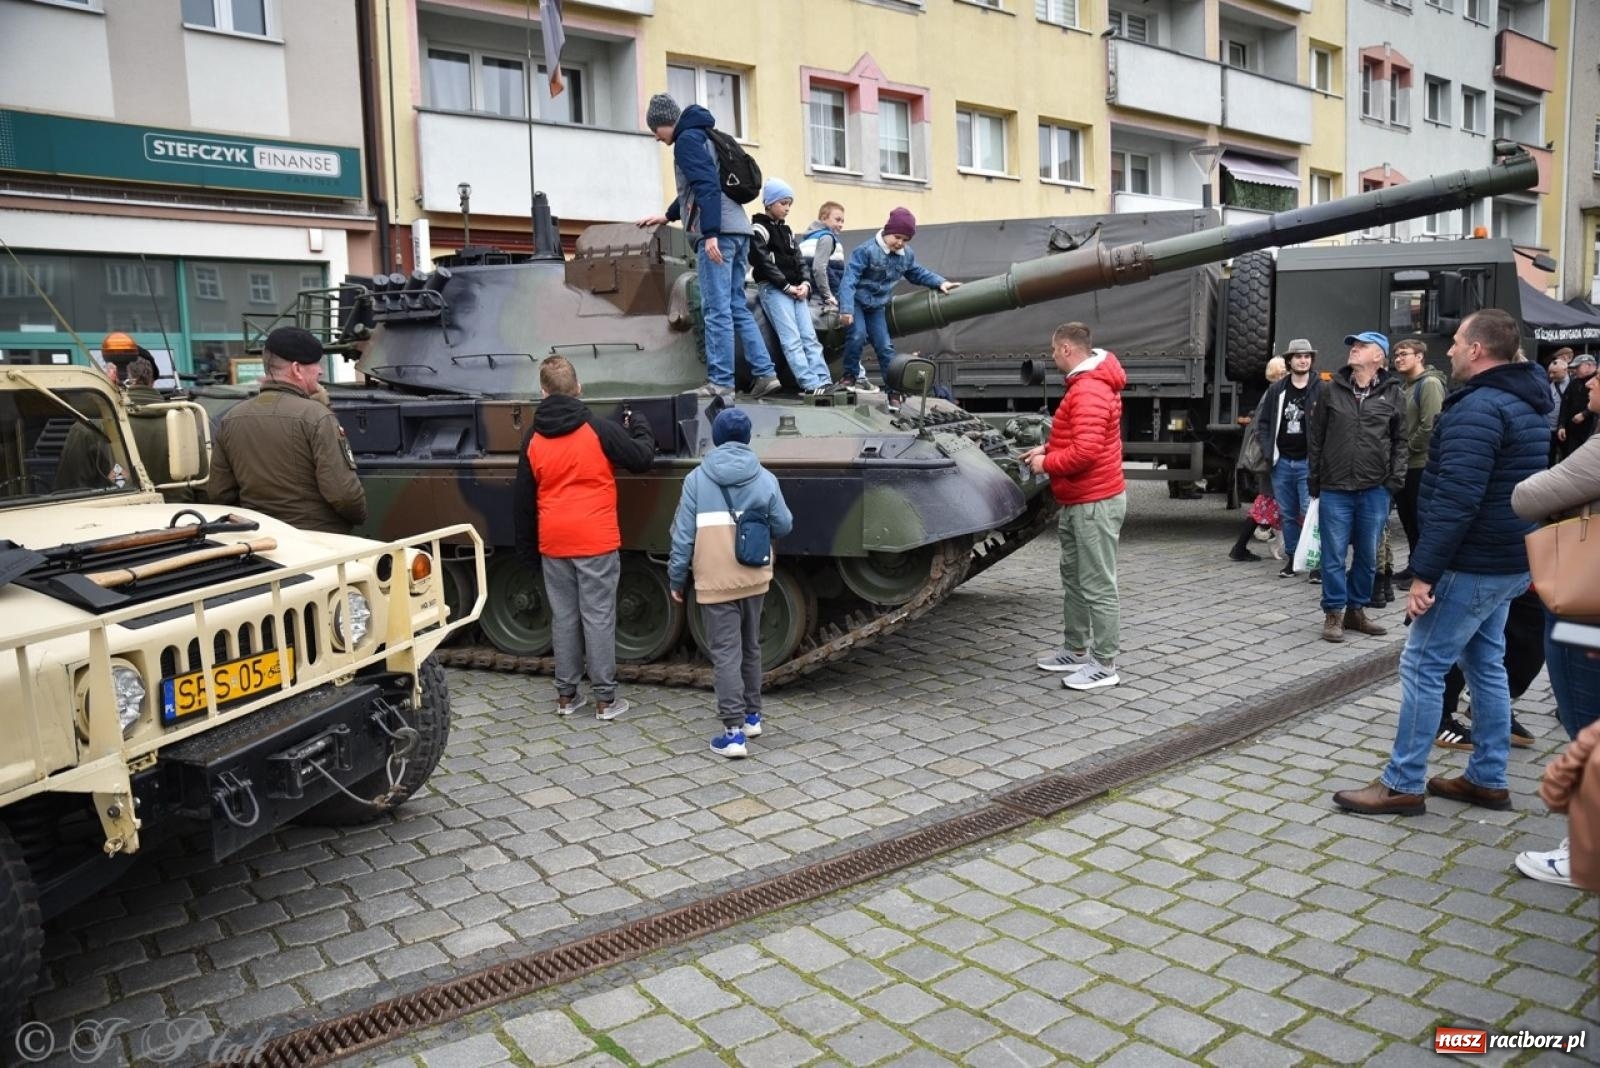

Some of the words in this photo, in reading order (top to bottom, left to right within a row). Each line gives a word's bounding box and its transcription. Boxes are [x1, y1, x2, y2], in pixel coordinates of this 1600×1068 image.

[153, 139, 249, 163] STEFCZYK
[259, 151, 332, 172] FINANSE
[240, 659, 264, 692] 05
[165, 704, 174, 714] PL
